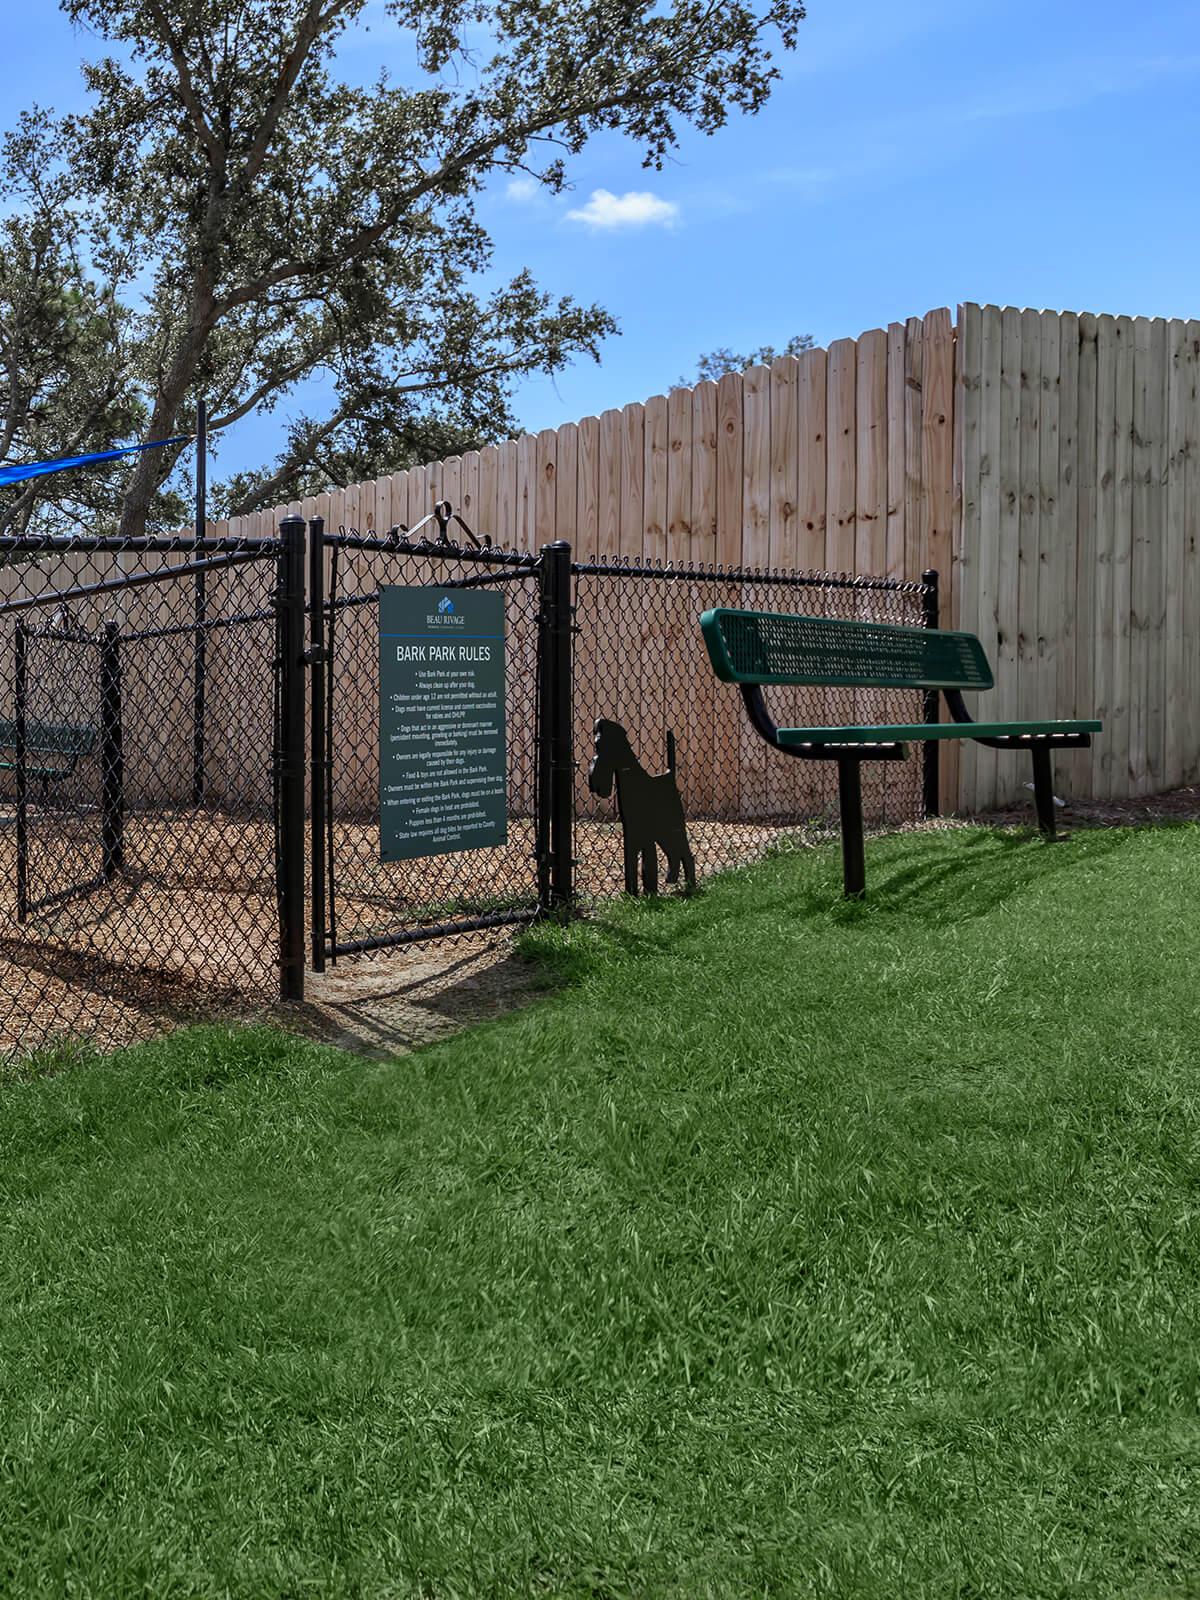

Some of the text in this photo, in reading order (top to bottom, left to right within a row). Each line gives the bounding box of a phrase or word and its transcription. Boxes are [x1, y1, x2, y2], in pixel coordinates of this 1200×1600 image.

[426, 615, 464, 624] BEAU RIVAGE
[397, 646, 490, 661] BARK PARK RULES
